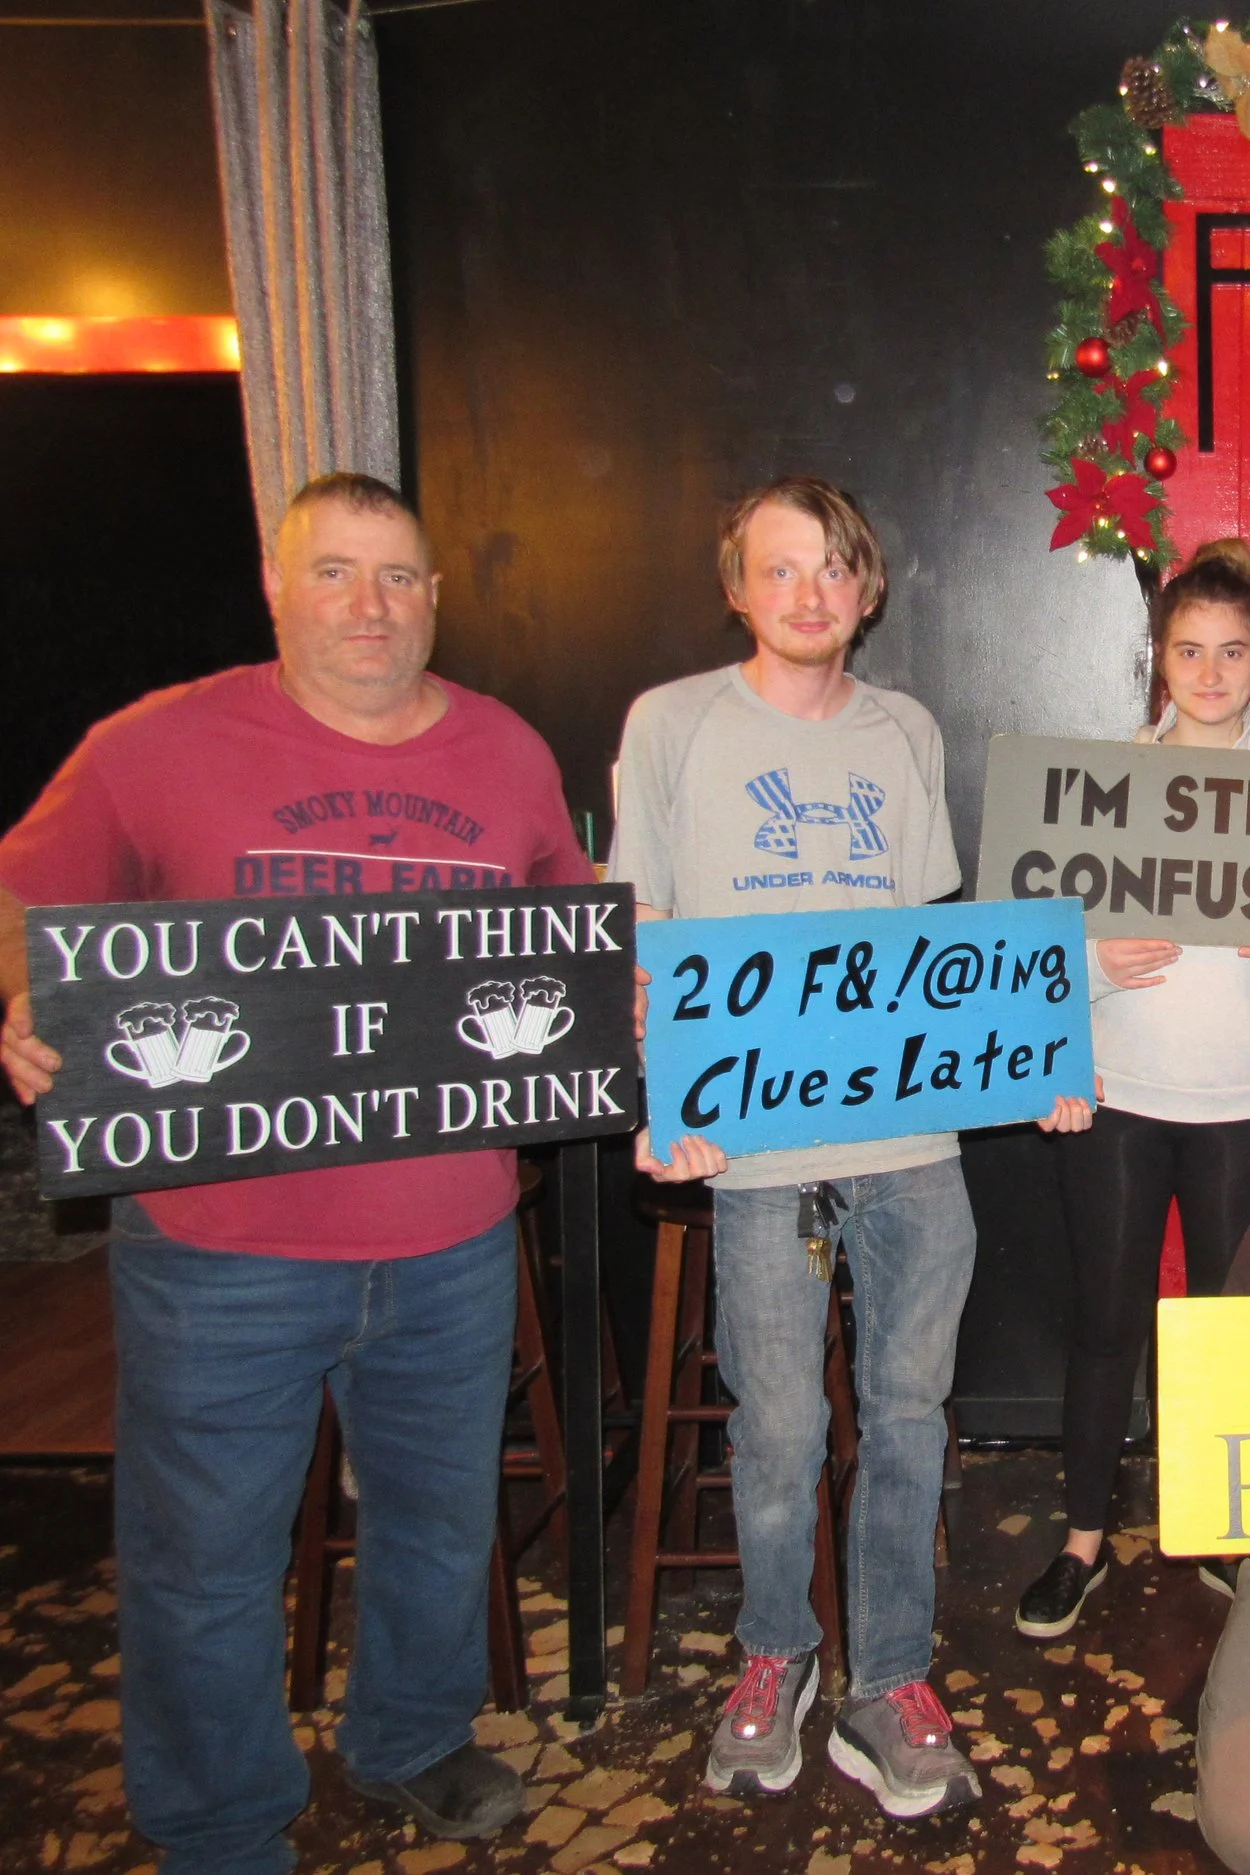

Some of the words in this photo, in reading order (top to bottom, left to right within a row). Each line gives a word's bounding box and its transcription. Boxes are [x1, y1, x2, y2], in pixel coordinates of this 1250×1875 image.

[273, 791, 357, 834] SMOKY
[363, 790, 484, 846] MOUNTAIN
[1043, 767, 1131, 829] I'M
[235, 855, 363, 895] DEER
[732, 872, 814, 891] UNDER
[45, 922, 202, 982] YOU
[225, 912, 420, 973] CAN'T
[437, 904, 622, 962] THINK
[673, 951, 775, 1022] 20
[332, 1002, 388, 1056] IF
[680, 1047, 879, 1129] Clues
[895, 1030, 1069, 1102] Later
[48, 1108, 204, 1173] YOU
[227, 1088, 419, 1156] DON'T
[438, 1068, 626, 1133] DRINK
